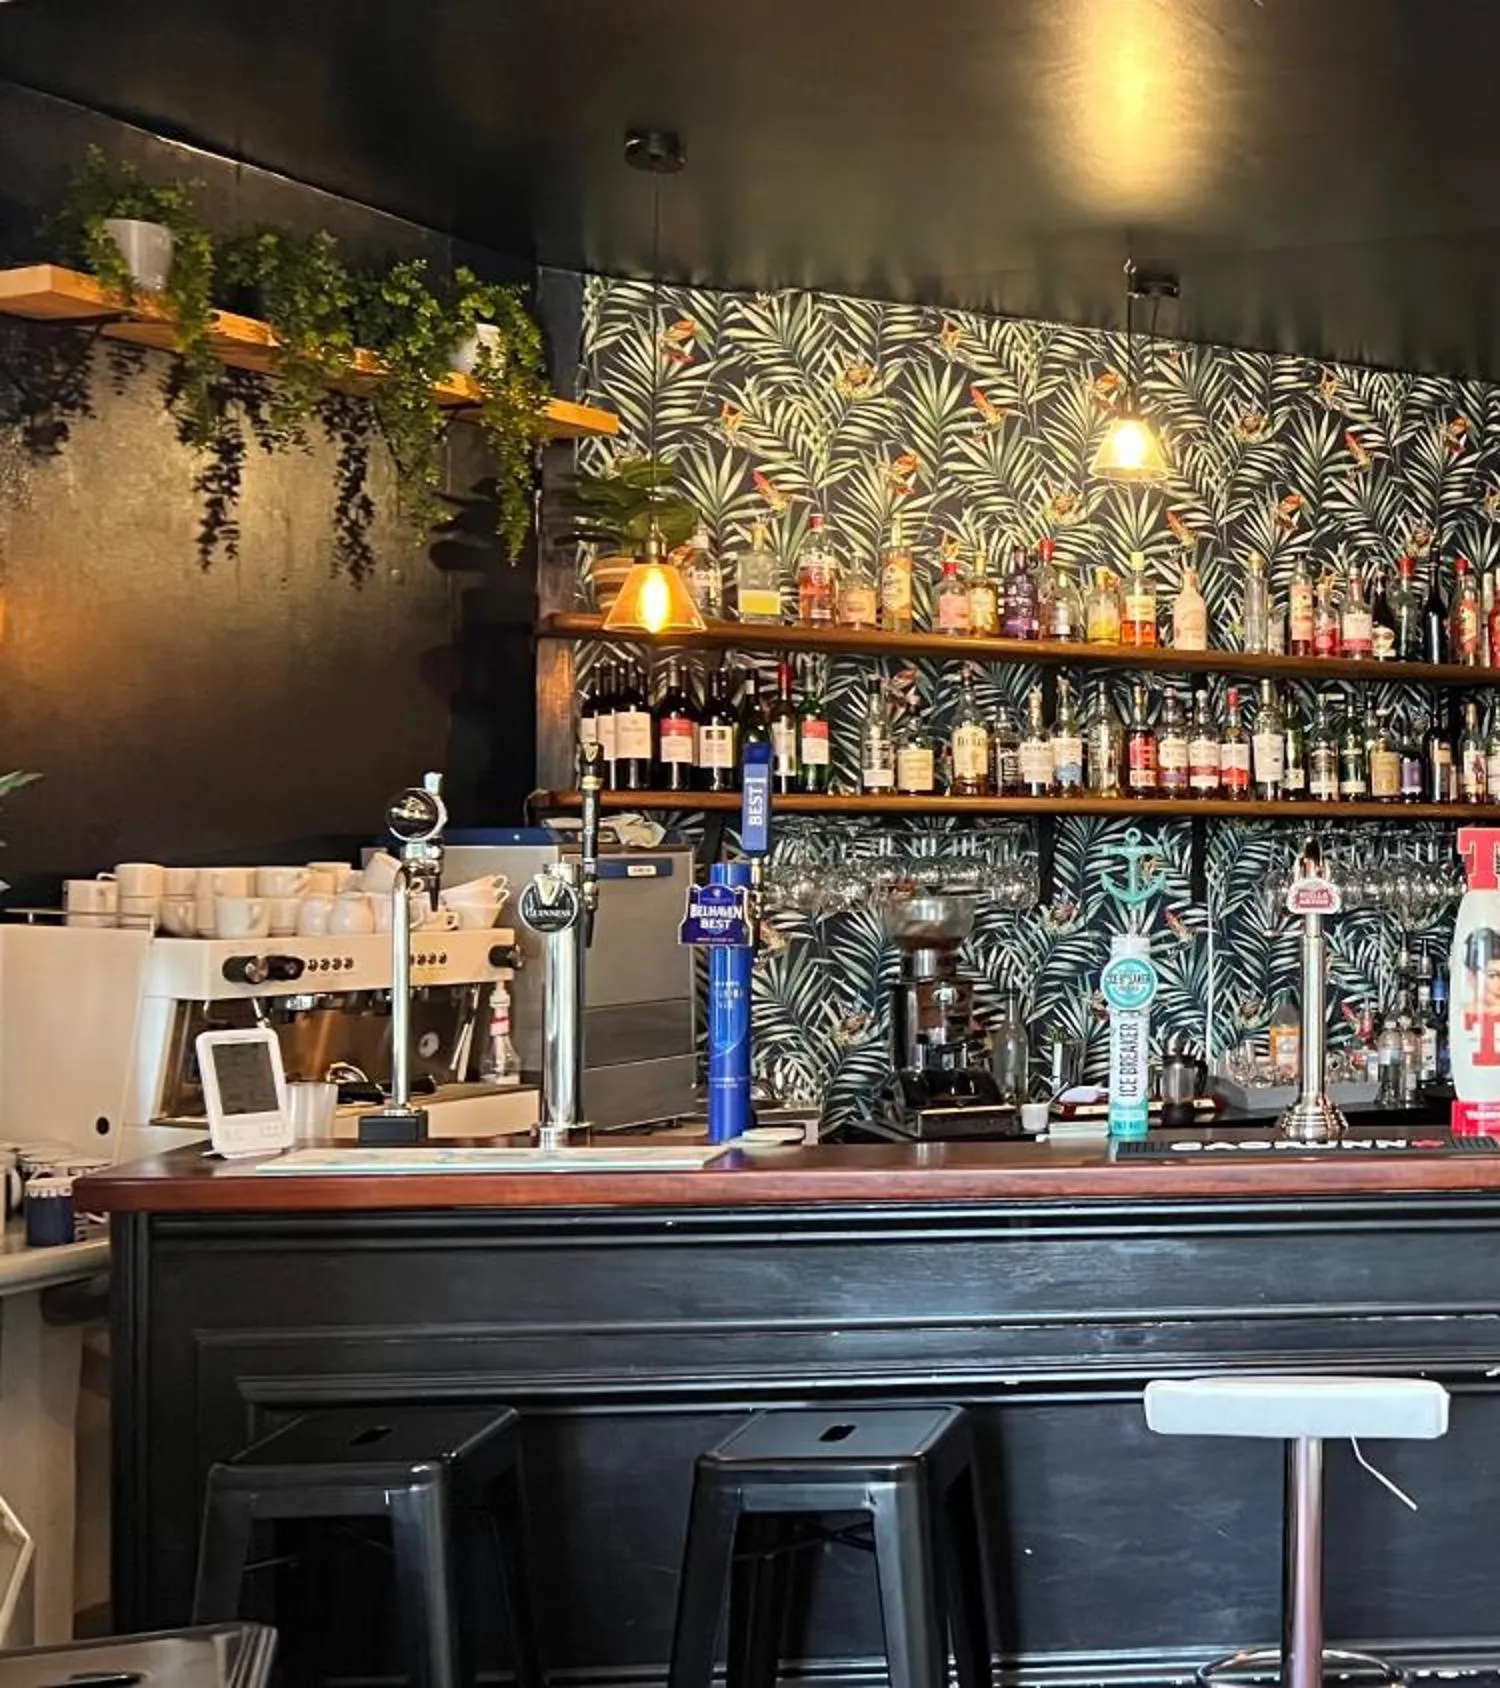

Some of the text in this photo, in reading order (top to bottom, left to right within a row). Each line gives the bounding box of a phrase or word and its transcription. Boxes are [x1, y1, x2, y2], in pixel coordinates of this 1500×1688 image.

[747, 785, 763, 826] BEST
[700, 919, 730, 929] BEST
[1119, 1023, 1139, 1075] BREAKER
[1119, 1078, 1138, 1097] ICE
